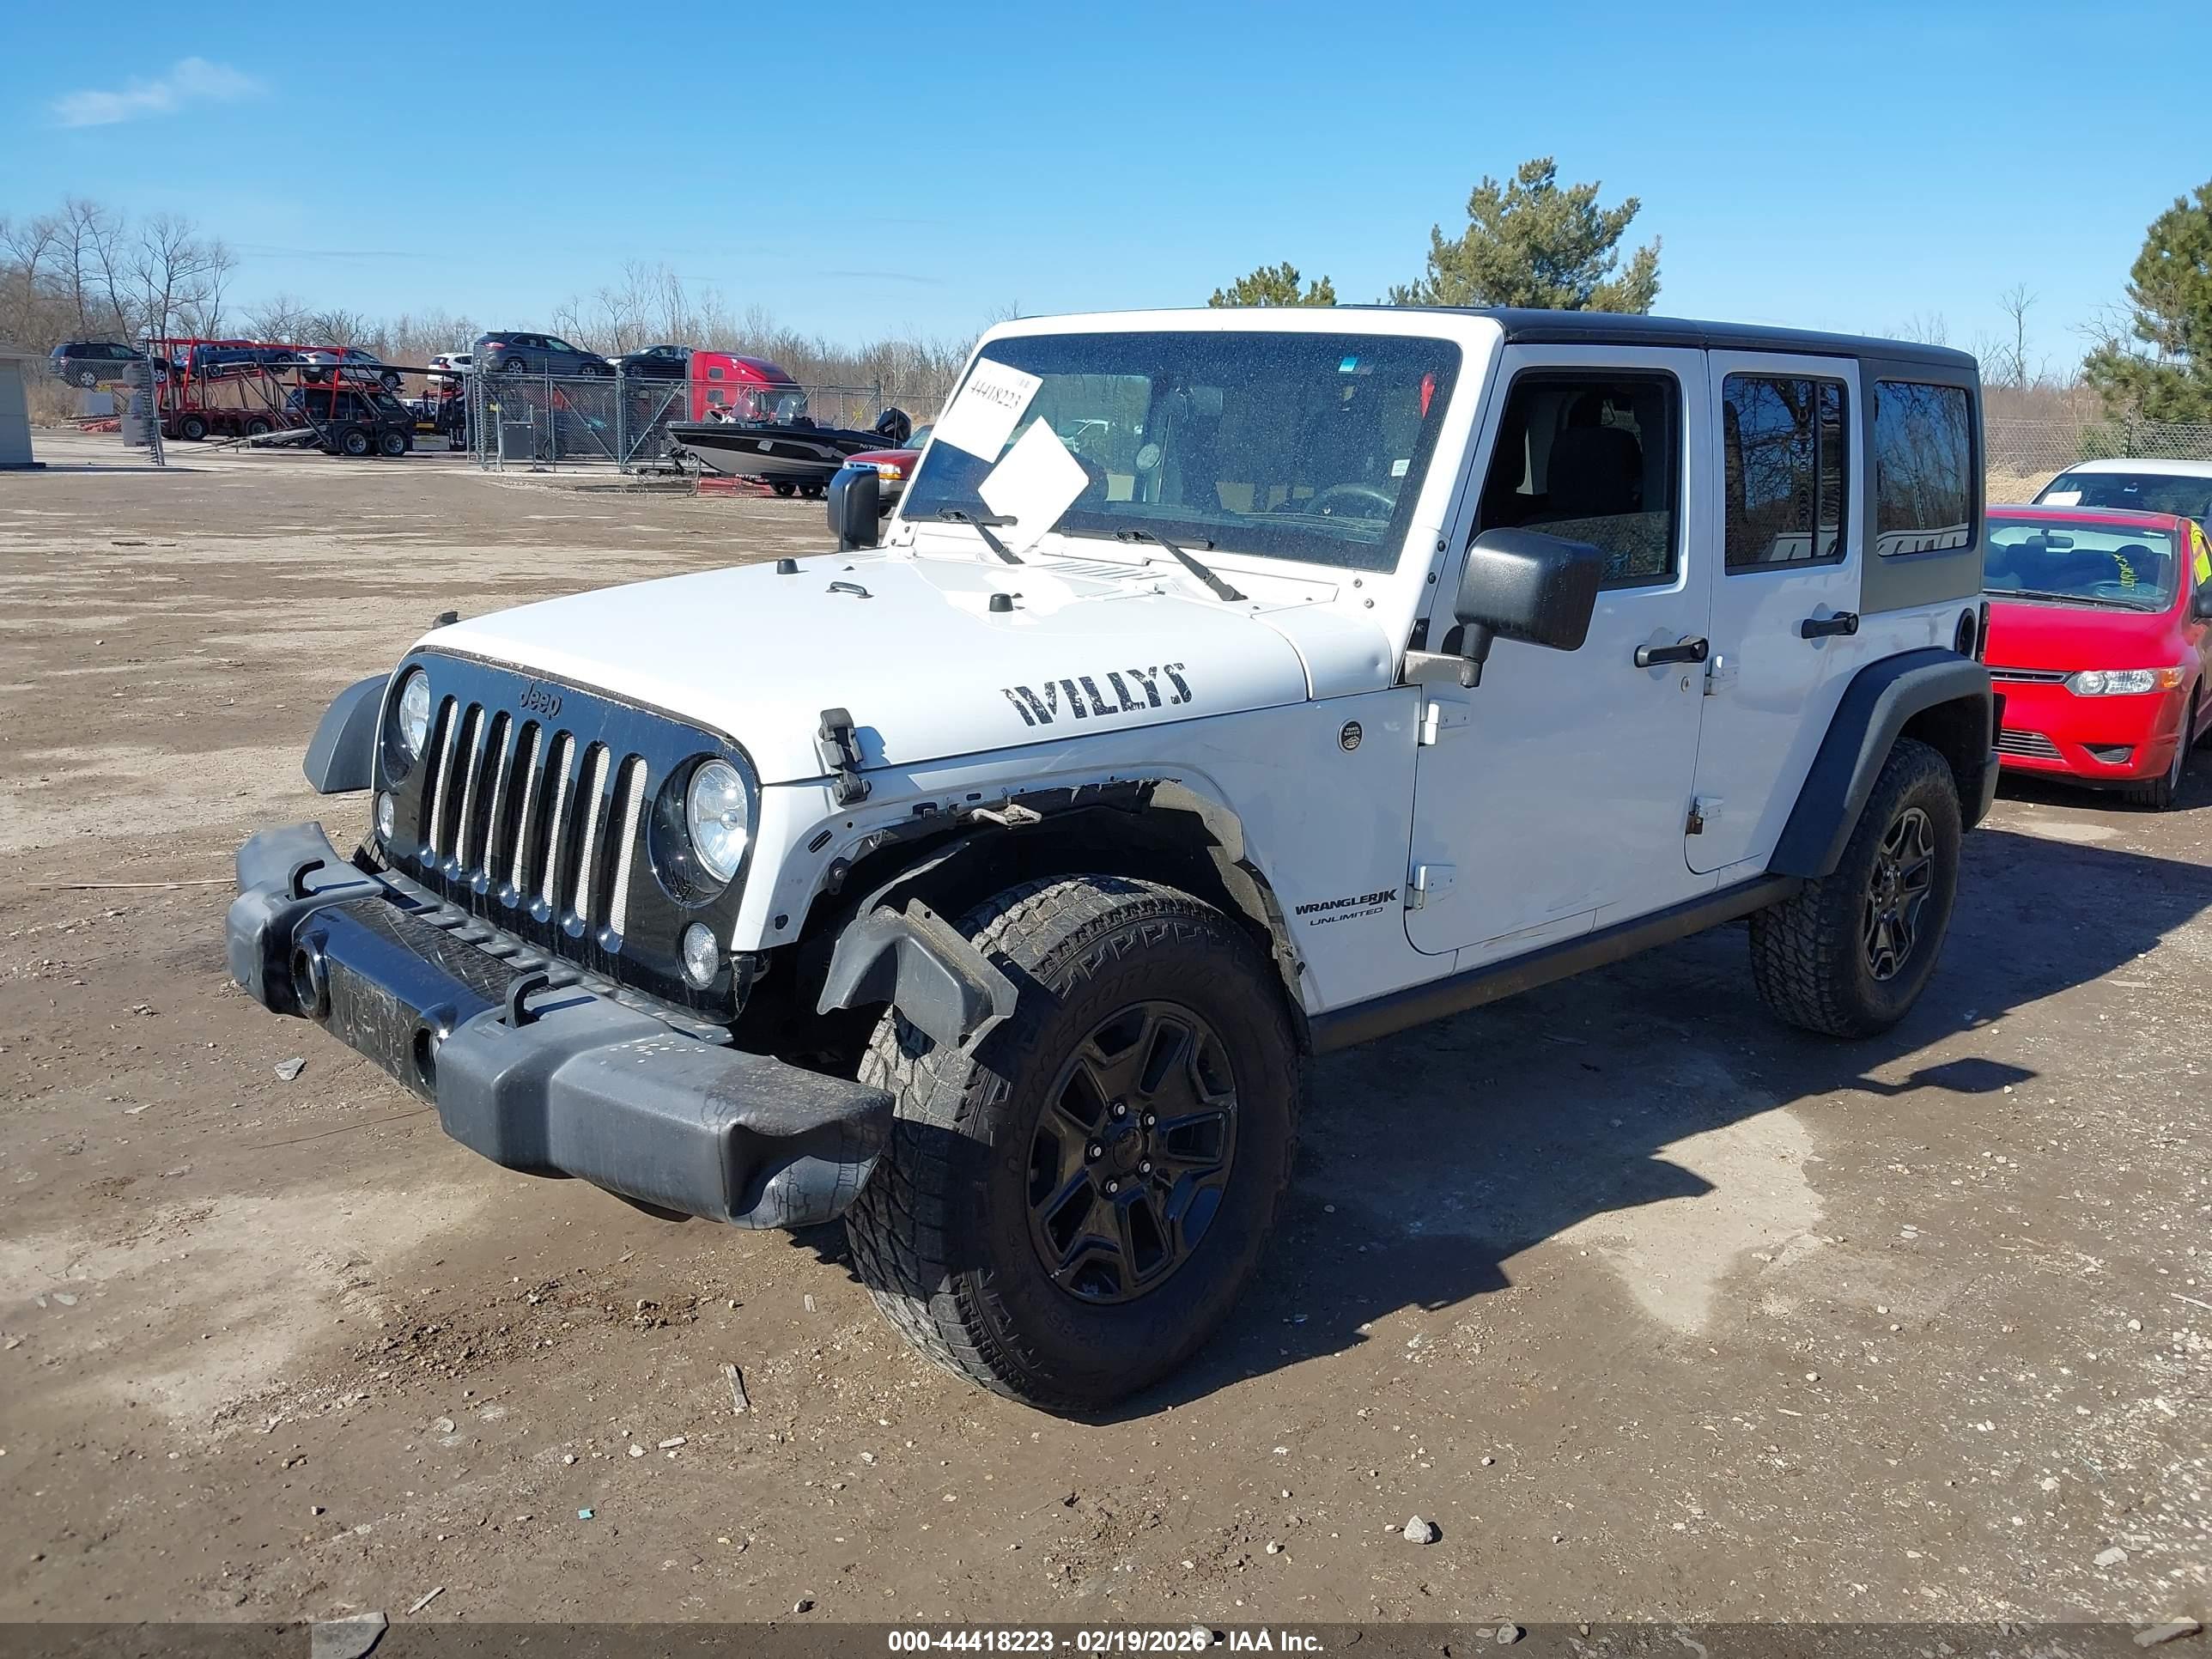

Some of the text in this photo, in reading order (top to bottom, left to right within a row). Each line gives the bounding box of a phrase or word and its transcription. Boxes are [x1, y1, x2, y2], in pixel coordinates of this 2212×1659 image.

[520, 682, 562, 721] Jeep
[1000, 662, 1192, 726] WILLYS
[1310, 907, 1383, 927] UNLIMITED
